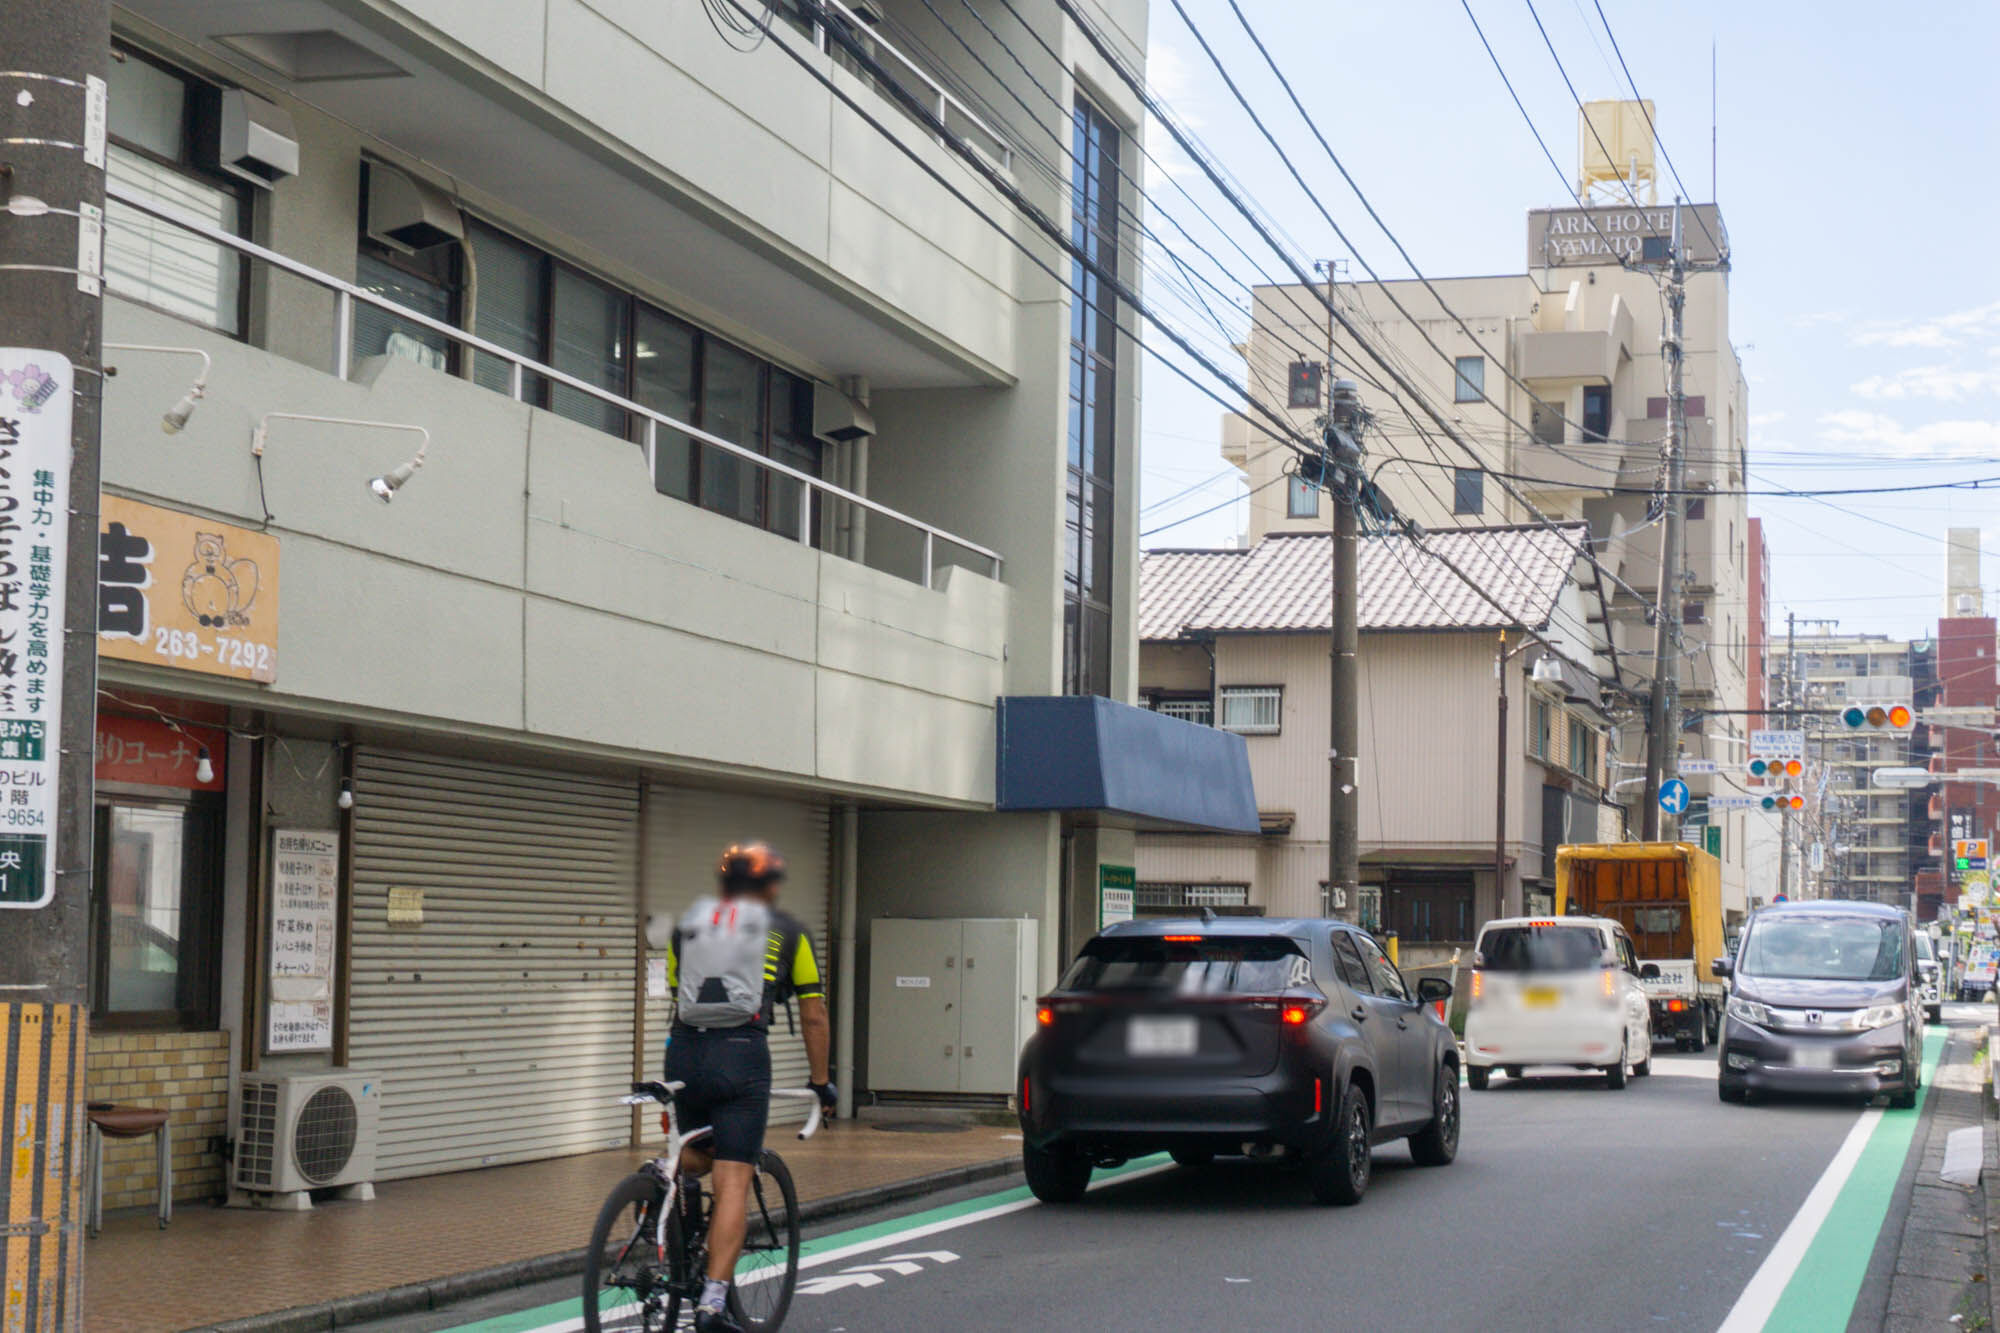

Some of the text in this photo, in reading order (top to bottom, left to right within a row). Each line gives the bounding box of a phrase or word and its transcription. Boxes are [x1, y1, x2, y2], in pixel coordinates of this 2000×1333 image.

[1551, 212, 1685, 235] ARK HOTE
[1550, 235, 1643, 257] YAMATO
[25, 469, 54, 713] 集中力・基礎学力を高めます
[155, 626, 269, 670] 263-7292
